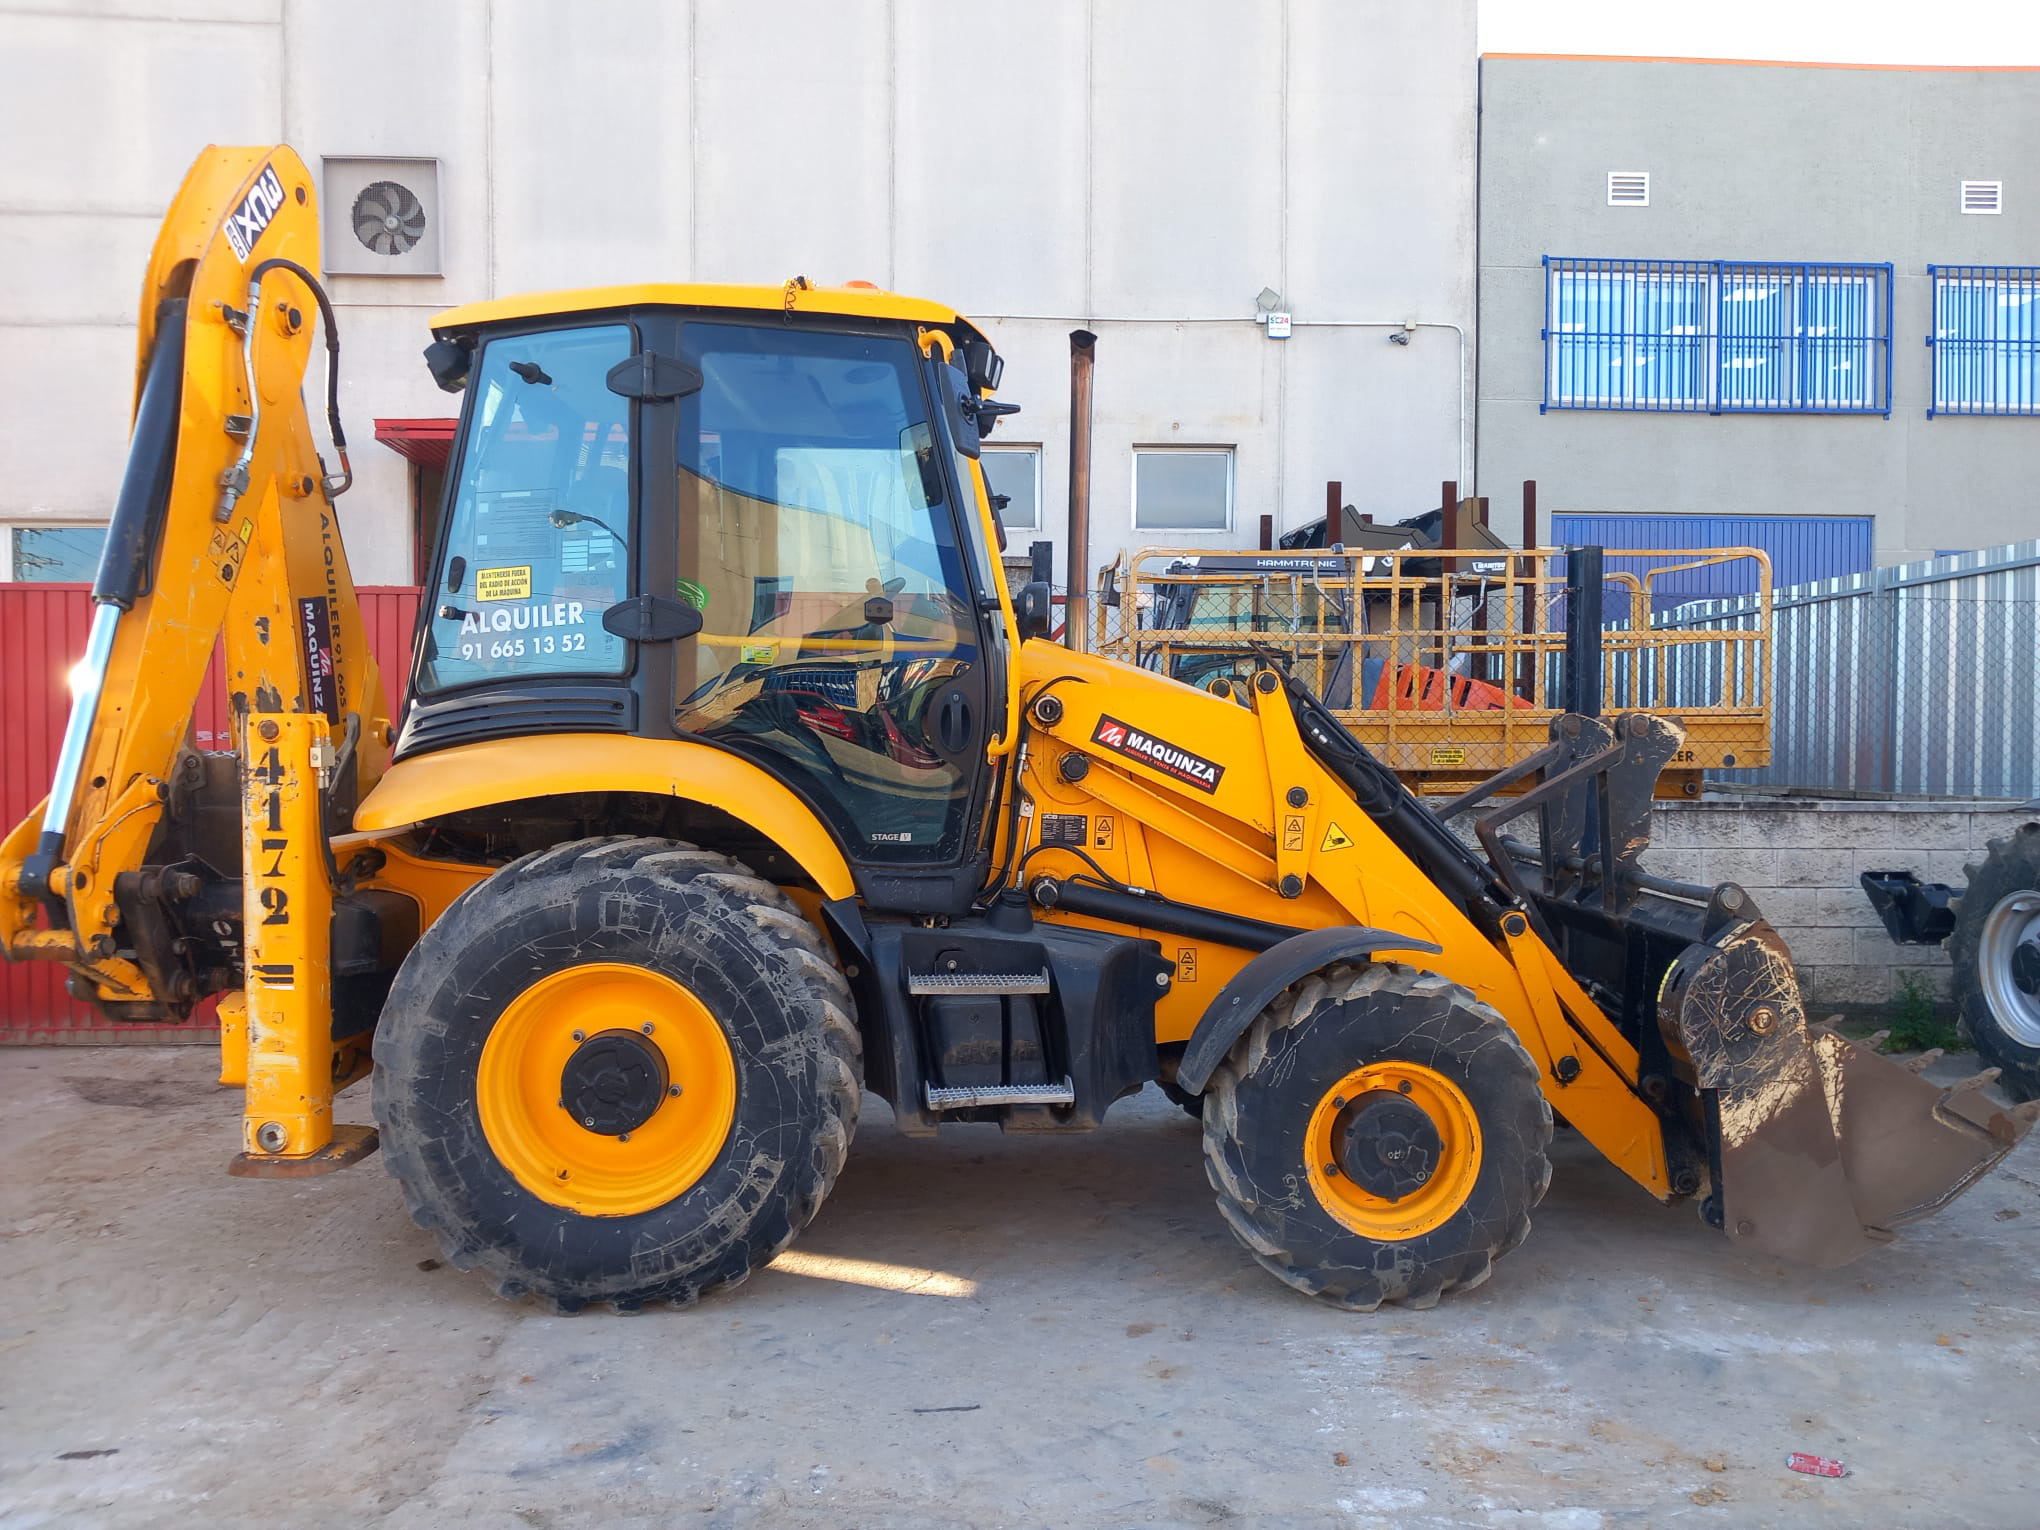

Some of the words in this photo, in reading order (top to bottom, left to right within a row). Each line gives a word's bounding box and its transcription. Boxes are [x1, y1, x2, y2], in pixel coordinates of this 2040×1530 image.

[319, 512, 341, 639] ALQUILER
[489, 580, 503, 588] RADIO
[460, 602, 585, 635] ALQUILER
[335, 643, 342, 664] 91
[461, 643, 482, 661] 91
[490, 640, 525, 658] 665
[532, 636, 555, 654] 13
[561, 633, 586, 652] 52
[338, 673, 347, 707] 665
[1126, 732, 1216, 783] MAQUINZA
